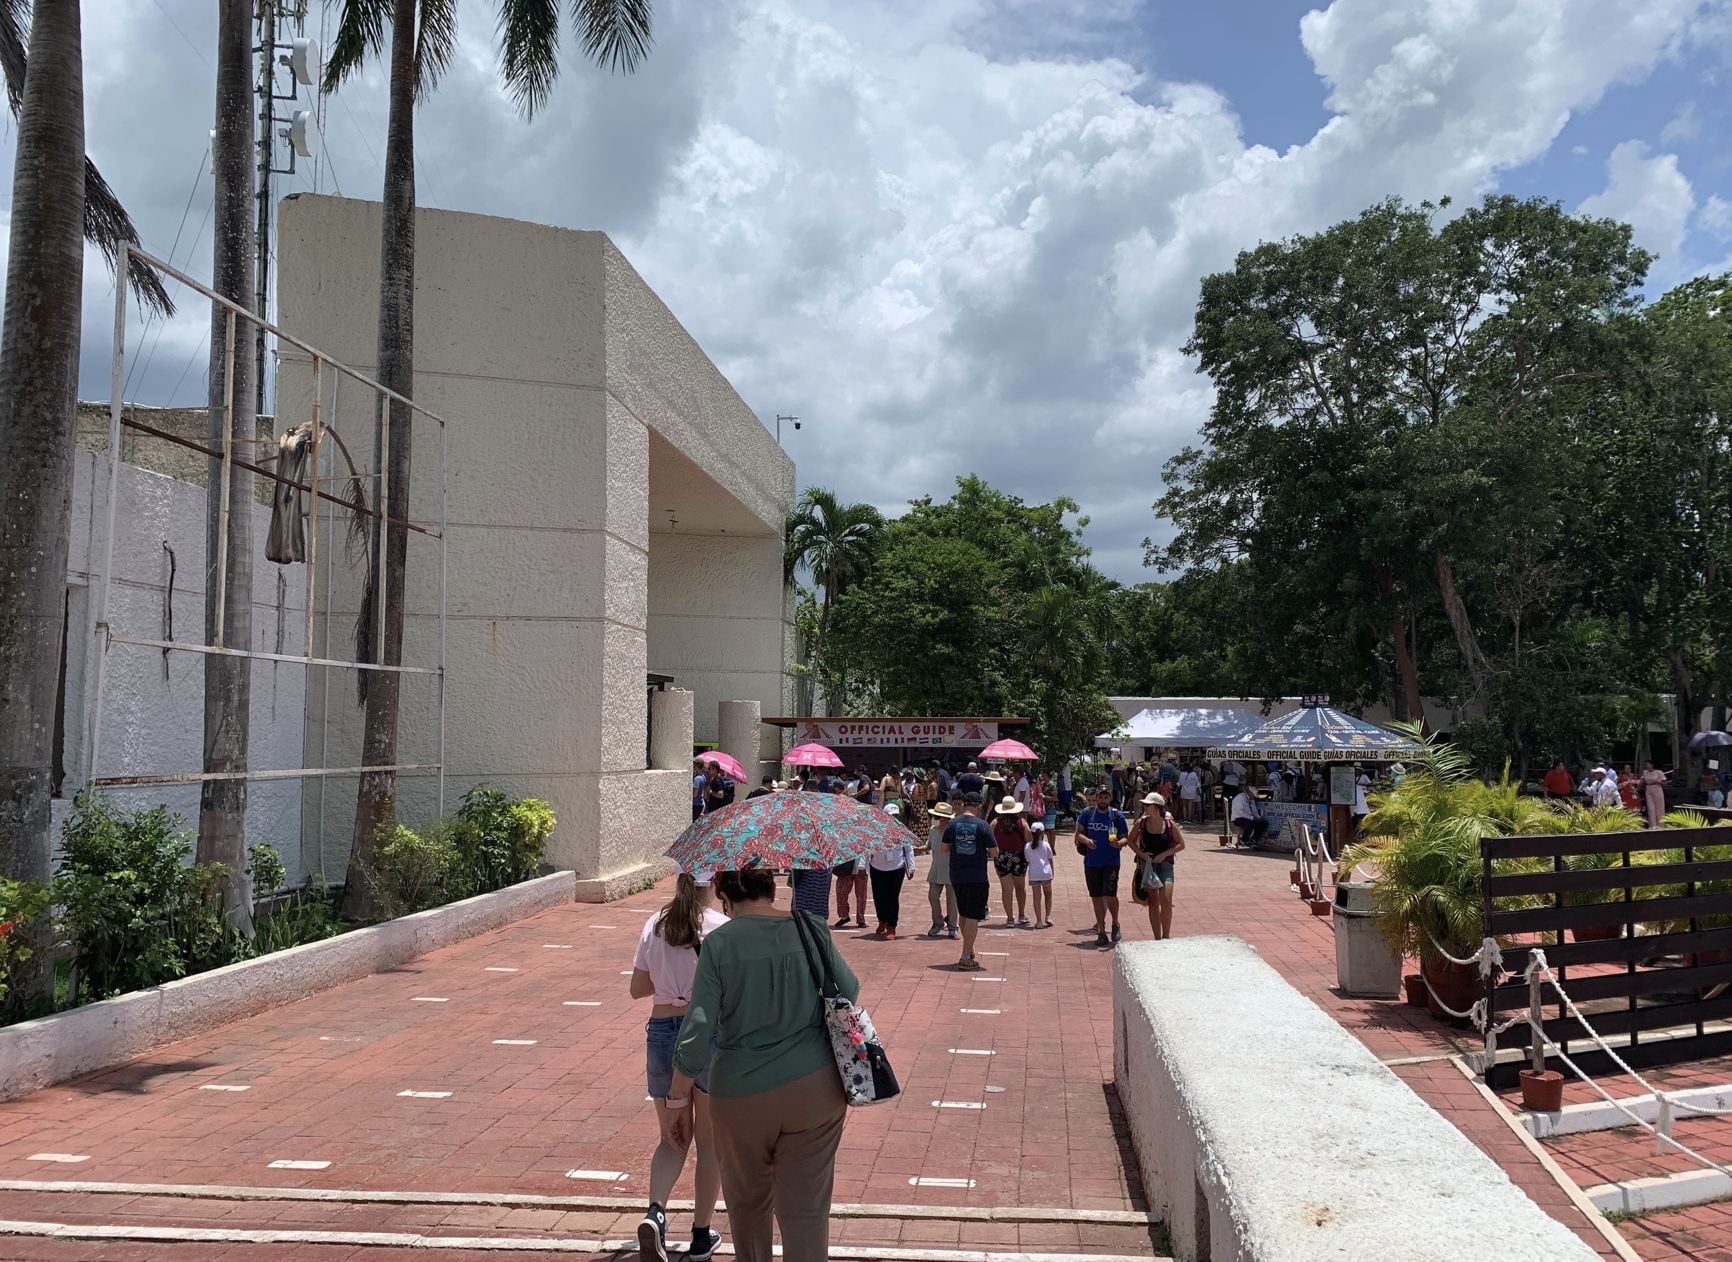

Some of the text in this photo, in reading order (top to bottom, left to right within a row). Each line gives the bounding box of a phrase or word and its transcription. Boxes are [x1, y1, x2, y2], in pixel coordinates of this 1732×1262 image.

[838, 725, 955, 735] OFFICIAL GUIDE
[1228, 749, 1261, 760] OFICIALES
[1267, 750, 1321, 760] OFFICIAL GUIDE
[1345, 750, 1379, 760] OFICIALES
[1275, 803, 1308, 811] WELCOME
